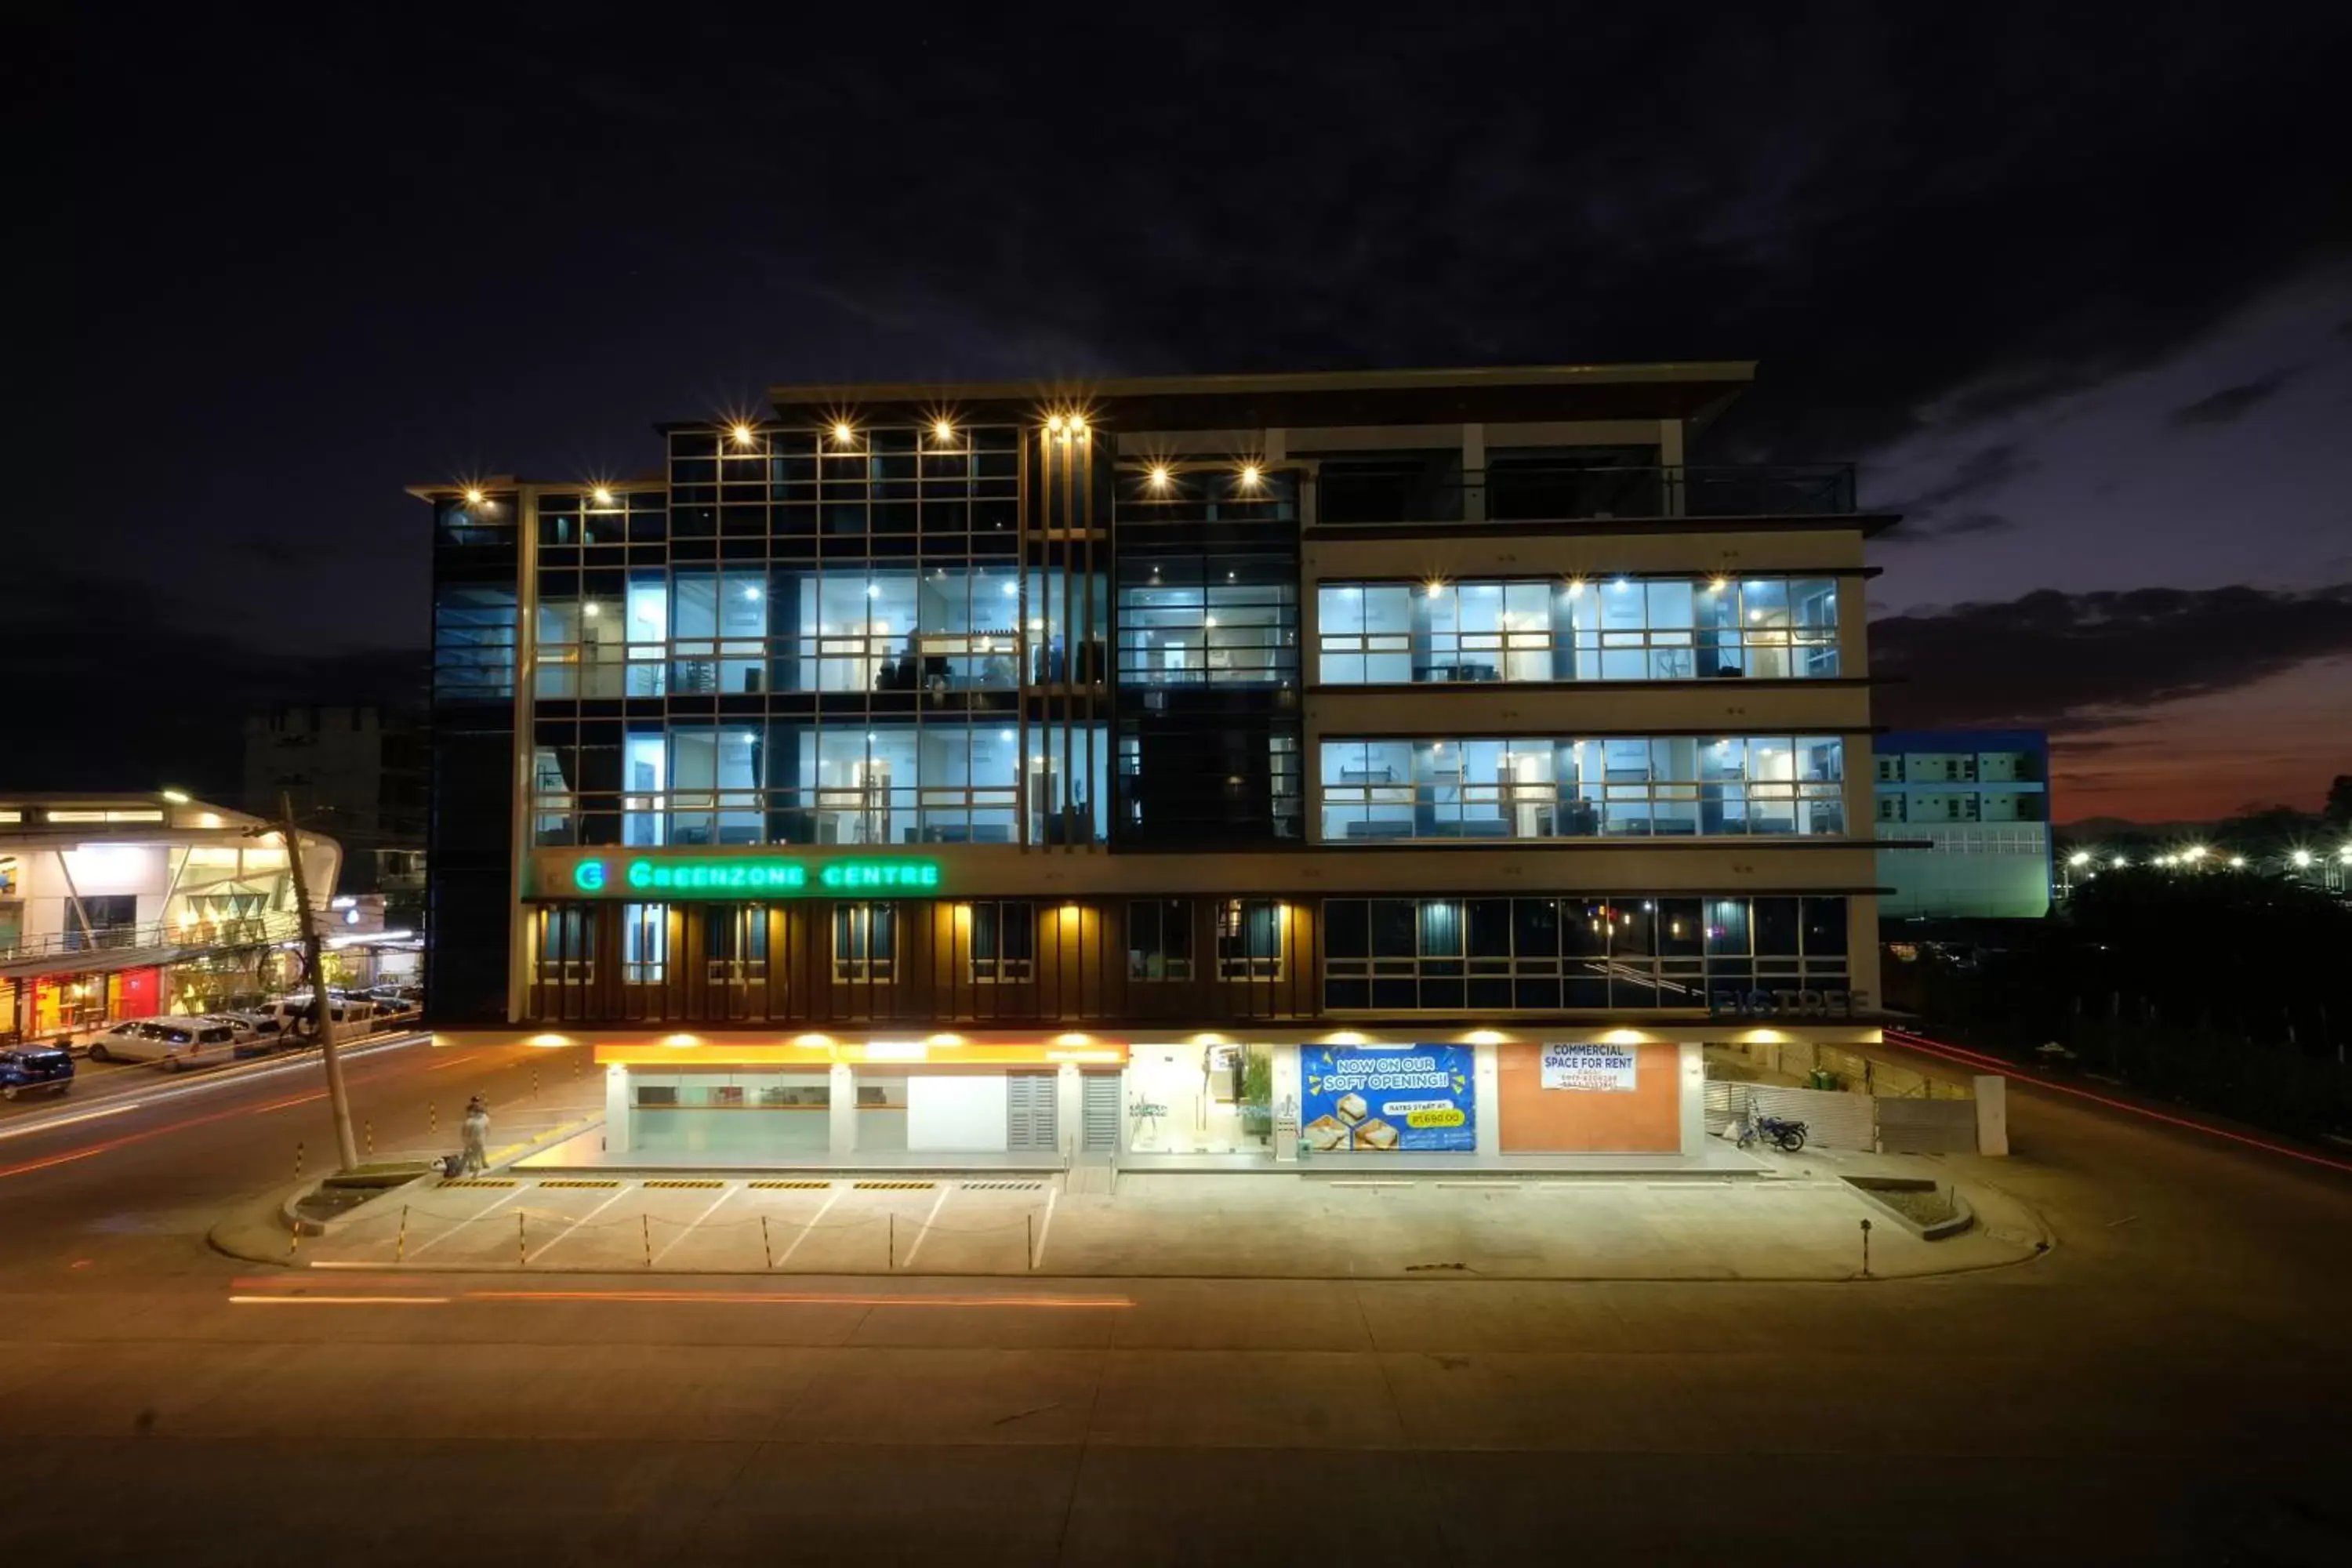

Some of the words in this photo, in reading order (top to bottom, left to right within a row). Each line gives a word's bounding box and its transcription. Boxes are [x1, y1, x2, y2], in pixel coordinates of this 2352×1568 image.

[630, 861, 804, 887] GREENZONE
[822, 865, 938, 887] CENTRE
[1553, 1044, 1624, 1055] COMMERCIAL
[1338, 1058, 1376, 1073] NOW
[1377, 1058, 1402, 1072] ON
[1402, 1056, 1436, 1071] OUR
[1544, 1057, 1578, 1069] SPACE
[1581, 1058, 1602, 1068] FOR
[1605, 1057, 1632, 1069] RENT
[1323, 1075, 1367, 1091] SOFT
[1368, 1072, 1449, 1089] OPENING!!
